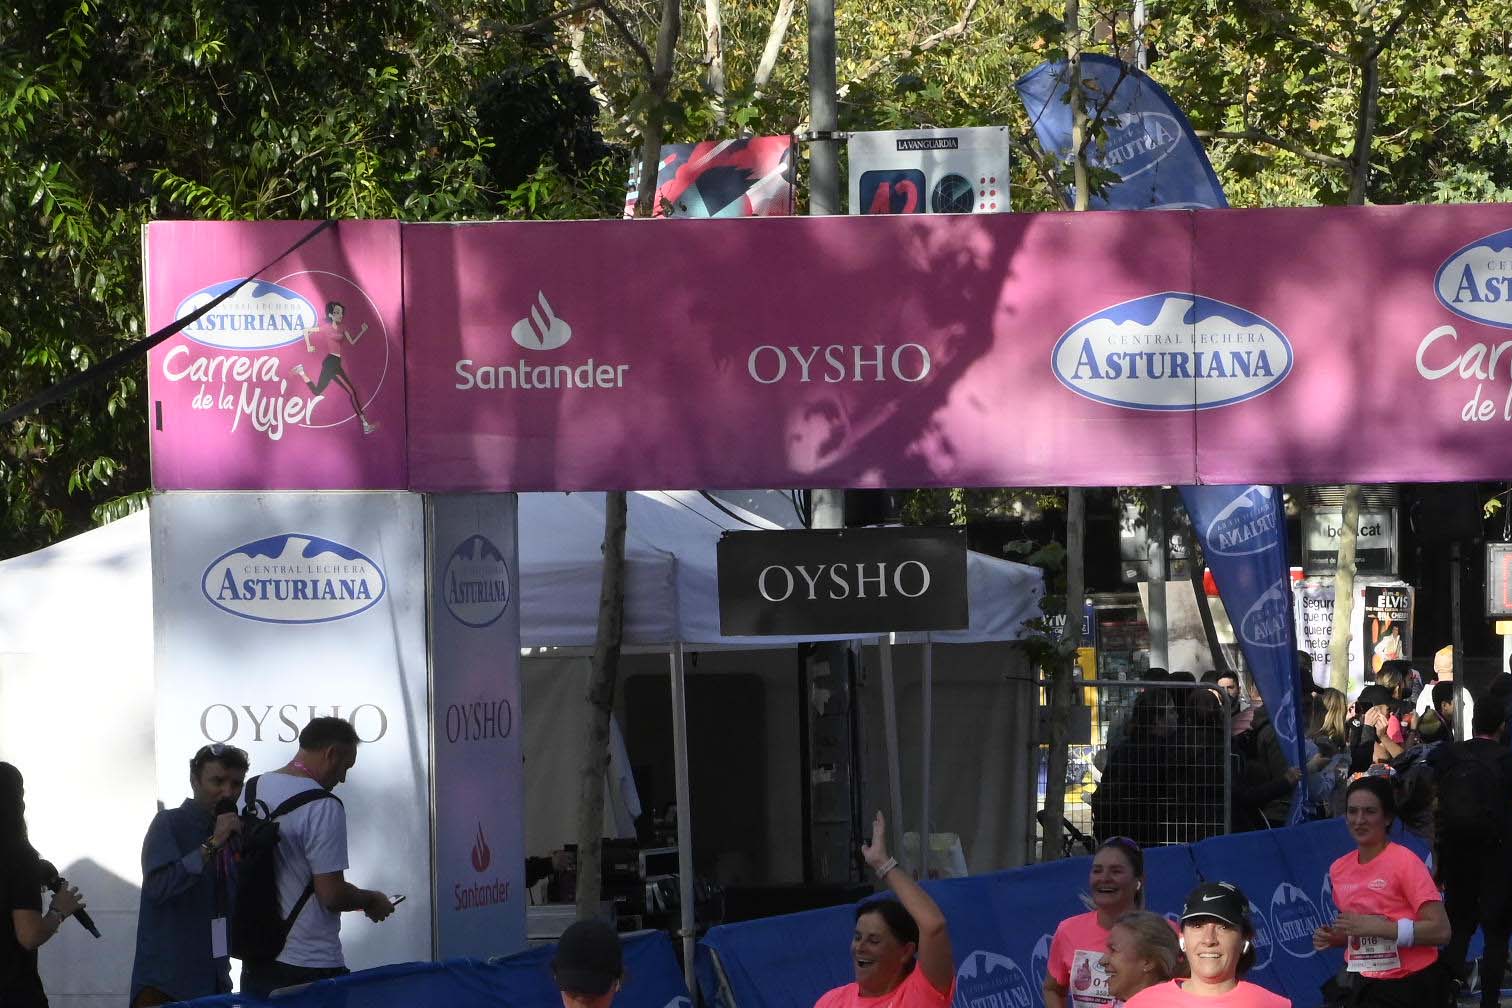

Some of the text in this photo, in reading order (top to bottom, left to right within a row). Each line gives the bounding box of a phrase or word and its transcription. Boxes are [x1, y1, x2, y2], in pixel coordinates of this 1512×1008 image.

[1107, 332, 1266, 346] CENTRAL LECHERA
[162, 345, 280, 382] Carrera
[455, 359, 628, 390] Santander
[748, 343, 931, 384] OYSHO
[1071, 337, 1274, 381] ASTURIANA
[192, 380, 326, 440] de la Mujer
[1461, 383, 1496, 422] de
[217, 567, 373, 601] ASTURIANA
[244, 564, 366, 574] CENTRAL LECHERA
[758, 560, 931, 602] OYSHO
[1377, 595, 1408, 608] ELVIS
[1304, 625, 1332, 637] quiere
[199, 703, 388, 744] OYSO
[445, 699, 513, 744] OYSHO
[454, 879, 511, 911] Santander
[1361, 936, 1378, 945] 016
[1093, 978, 1110, 988] 01
